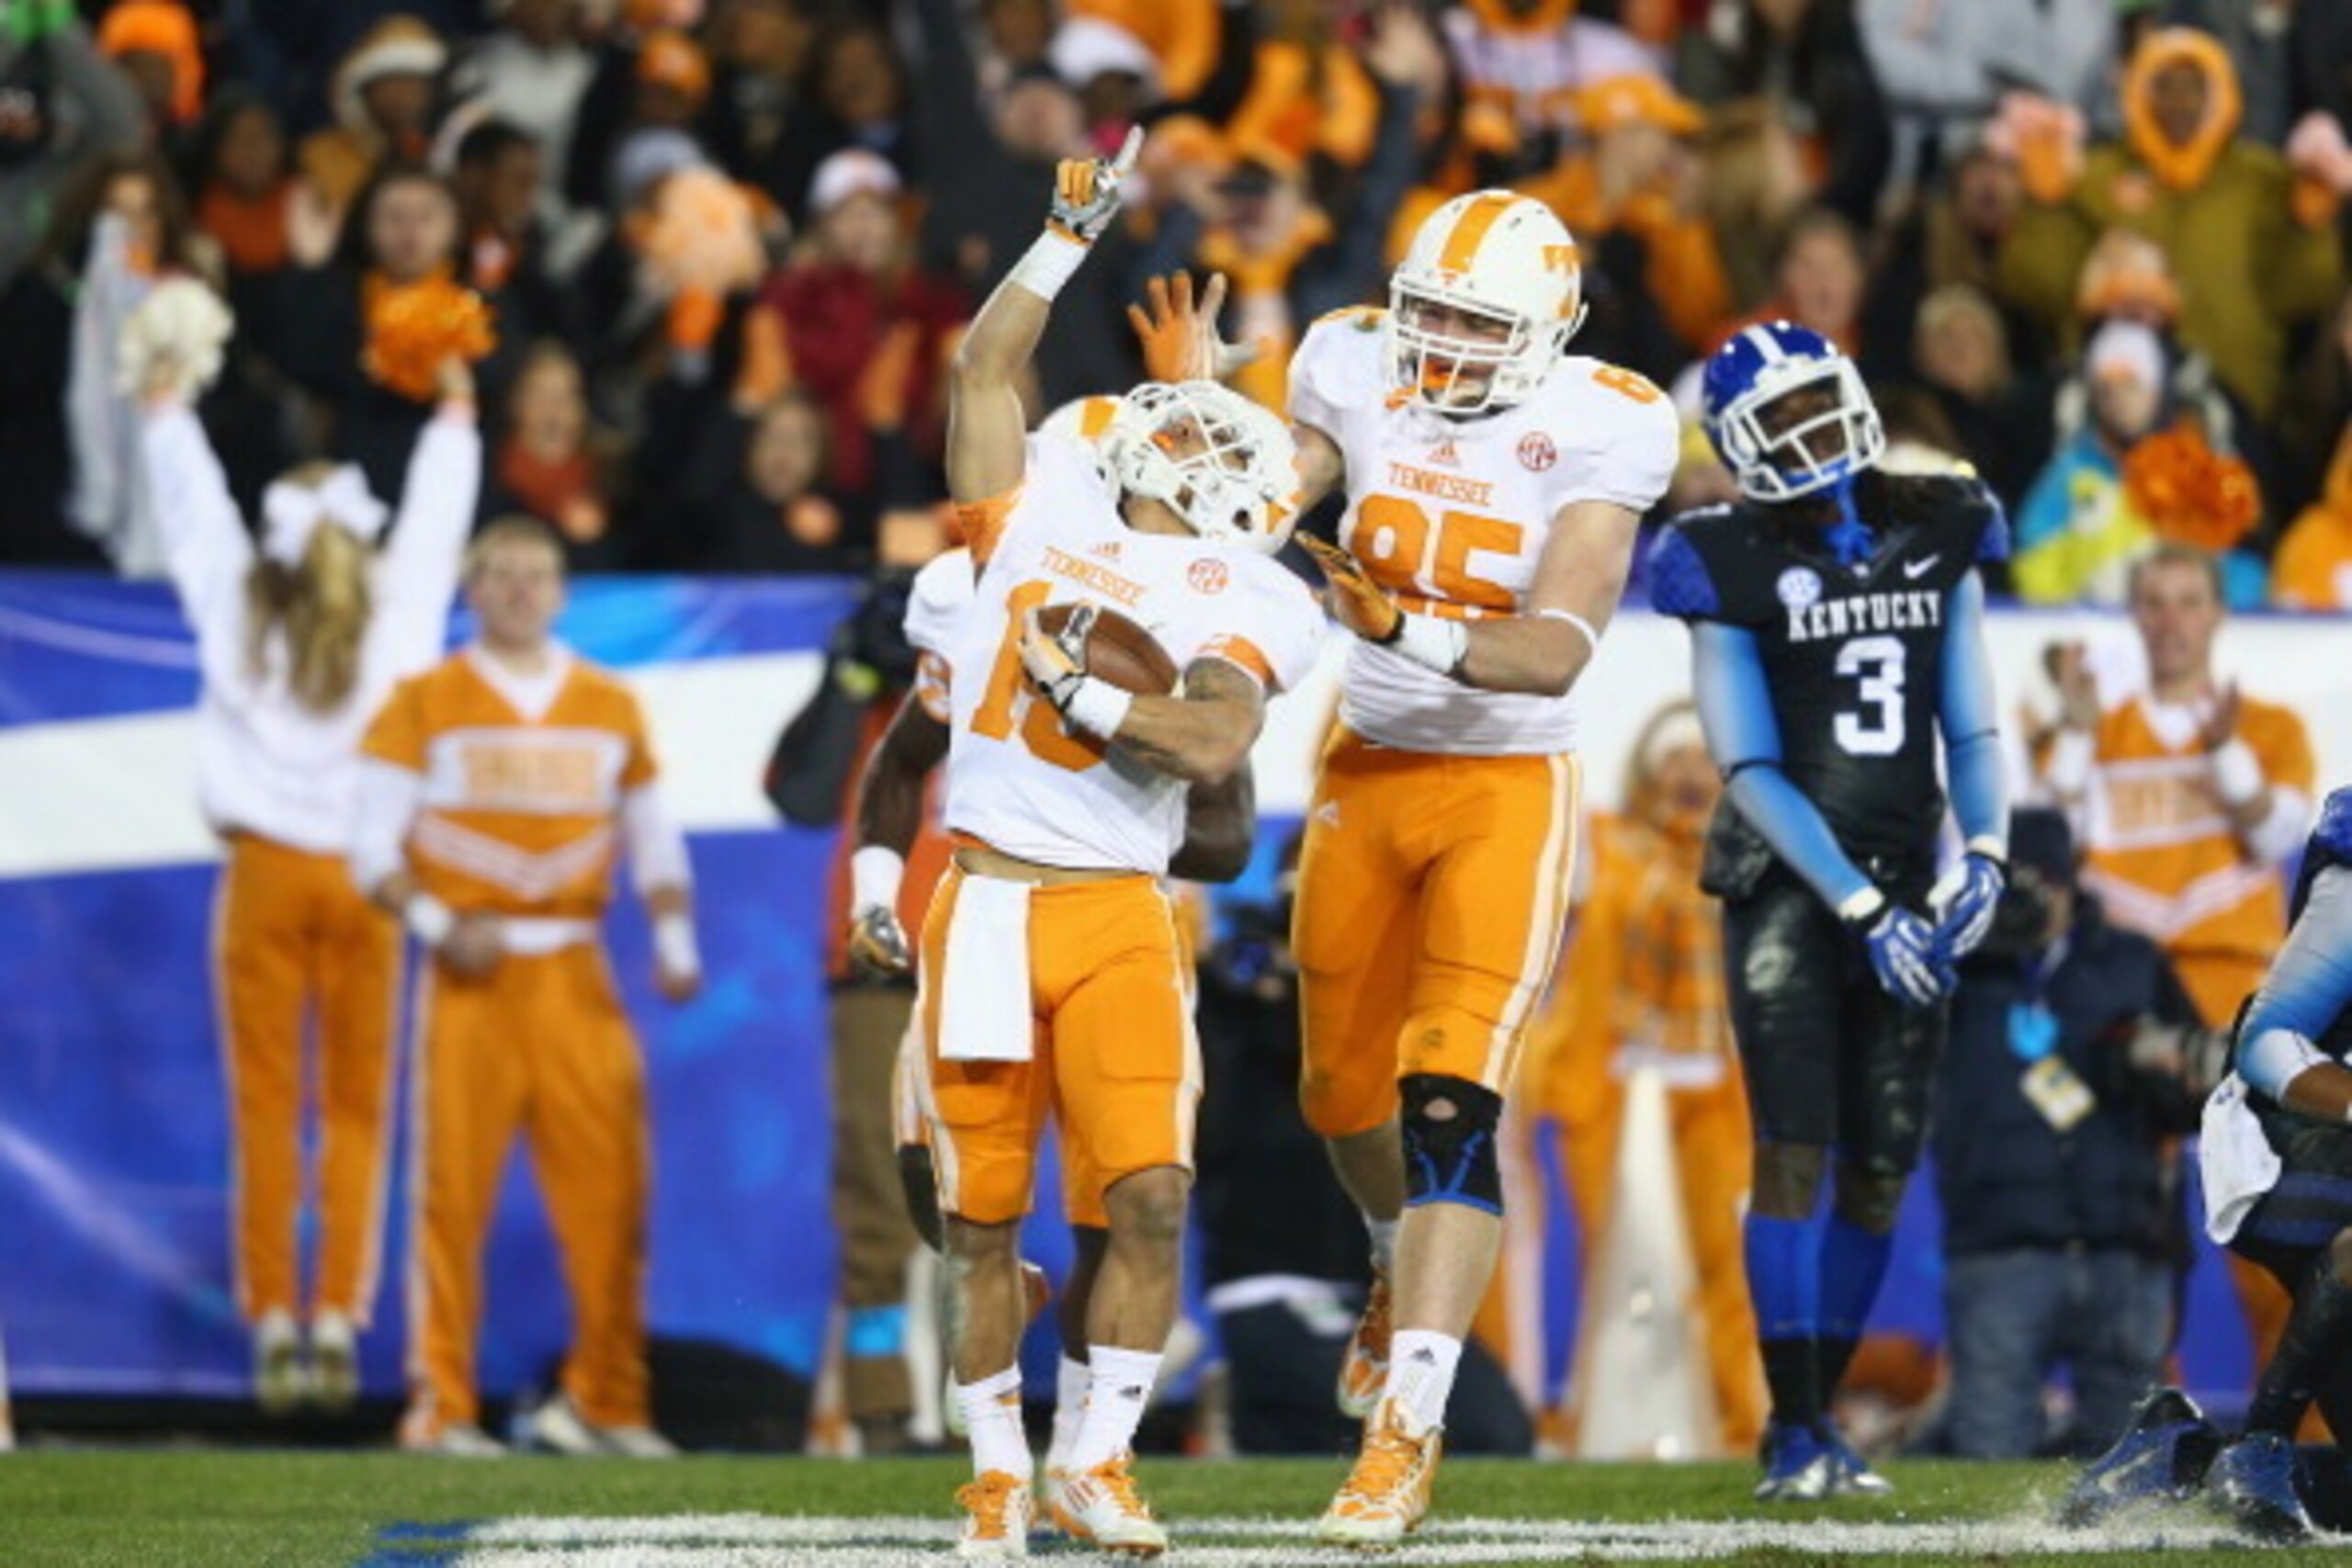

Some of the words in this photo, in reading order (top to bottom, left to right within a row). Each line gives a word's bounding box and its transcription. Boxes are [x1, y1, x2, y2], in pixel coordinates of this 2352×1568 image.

[1388, 462, 1494, 507] TENNESSEE
[1040, 545, 1148, 607] TENNESSEE
[1789, 592, 1941, 641] KENTUCKY
[1834, 636, 1906, 755] 3
